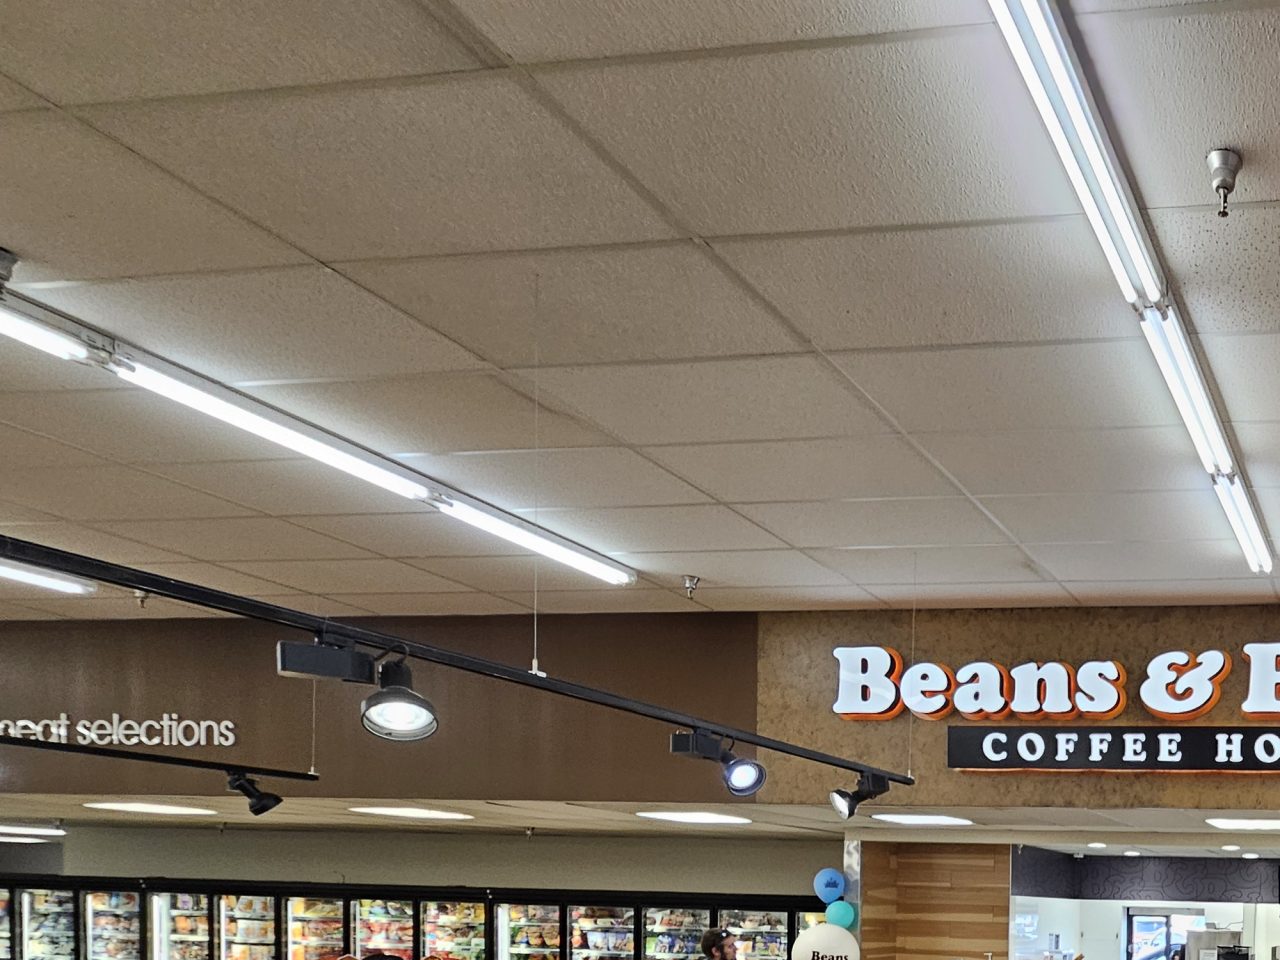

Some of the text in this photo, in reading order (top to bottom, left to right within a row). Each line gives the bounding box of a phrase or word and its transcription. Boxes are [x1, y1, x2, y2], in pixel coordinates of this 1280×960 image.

[832, 645, 1122, 719] Beans
[1139, 649, 1230, 719] &
[76, 713, 236, 746] selections
[982, 731, 1184, 764] COFFEE
